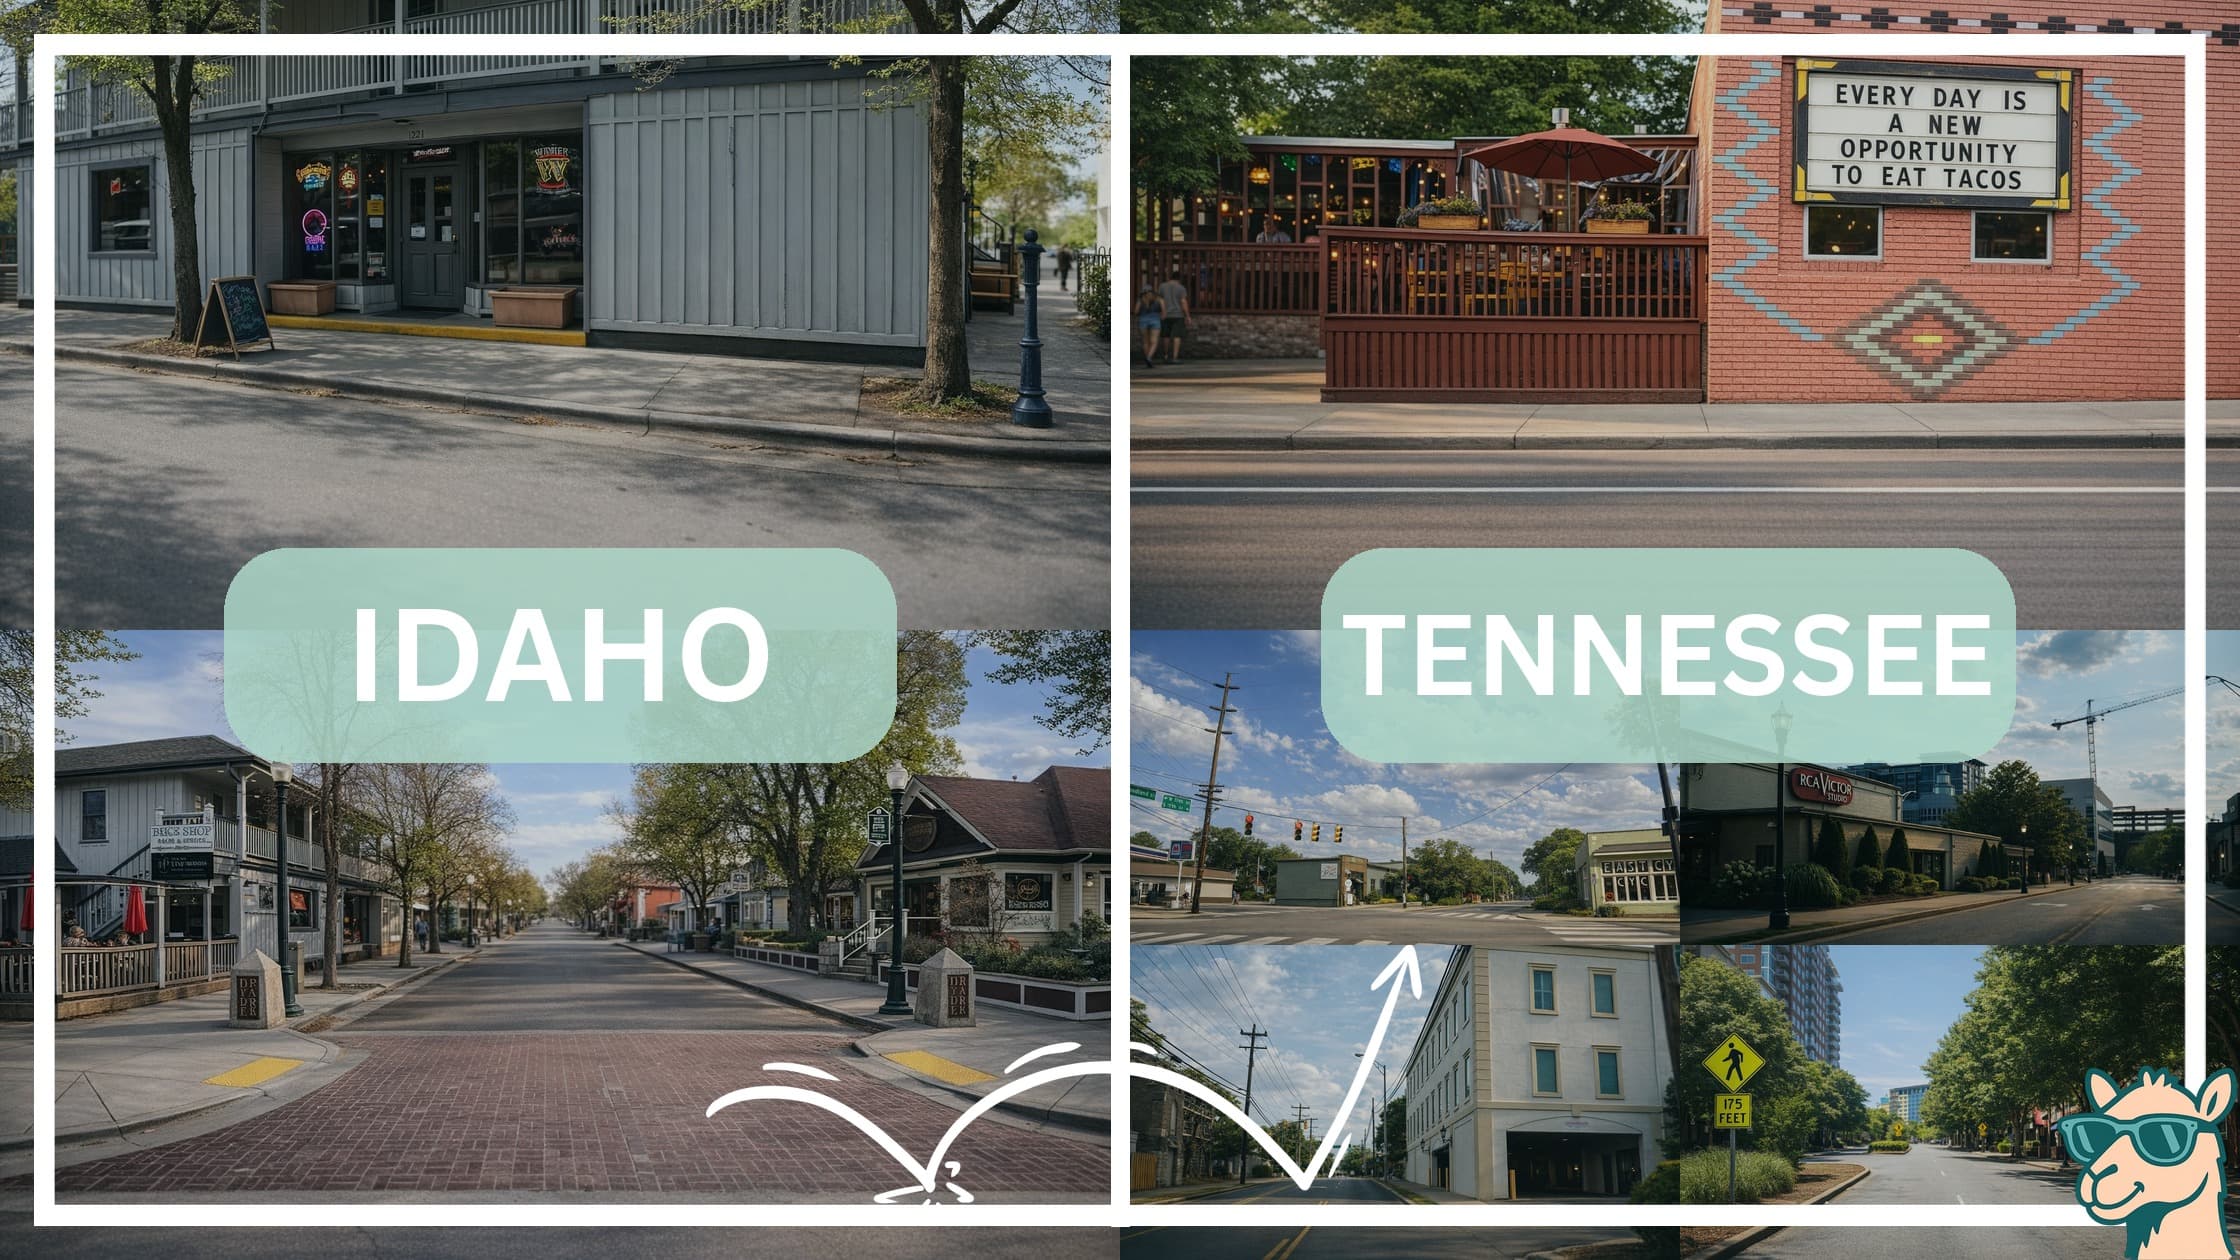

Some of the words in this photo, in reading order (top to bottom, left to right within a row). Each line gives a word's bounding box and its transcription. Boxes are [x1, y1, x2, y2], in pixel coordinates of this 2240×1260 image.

[1836, 83, 1915, 105] EVERY
[1934, 87, 1981, 109] DAY
[2004, 90, 2026, 111] IS
[1888, 113, 1903, 133] A
[1929, 114, 1982, 135] NEW
[1840, 138, 2017, 164] OPPORTUNITY
[1831, 164, 1862, 185] TO
[1882, 166, 1927, 187] EAT
[1943, 168, 2021, 190] TACOS
[1800, 773, 1820, 790] RCA
[182, 825, 212, 836] SHOP
[1604, 861, 1648, 873] EAST
[1724, 1098, 1743, 1110] 175
[1719, 1112, 1747, 1124] FEET
